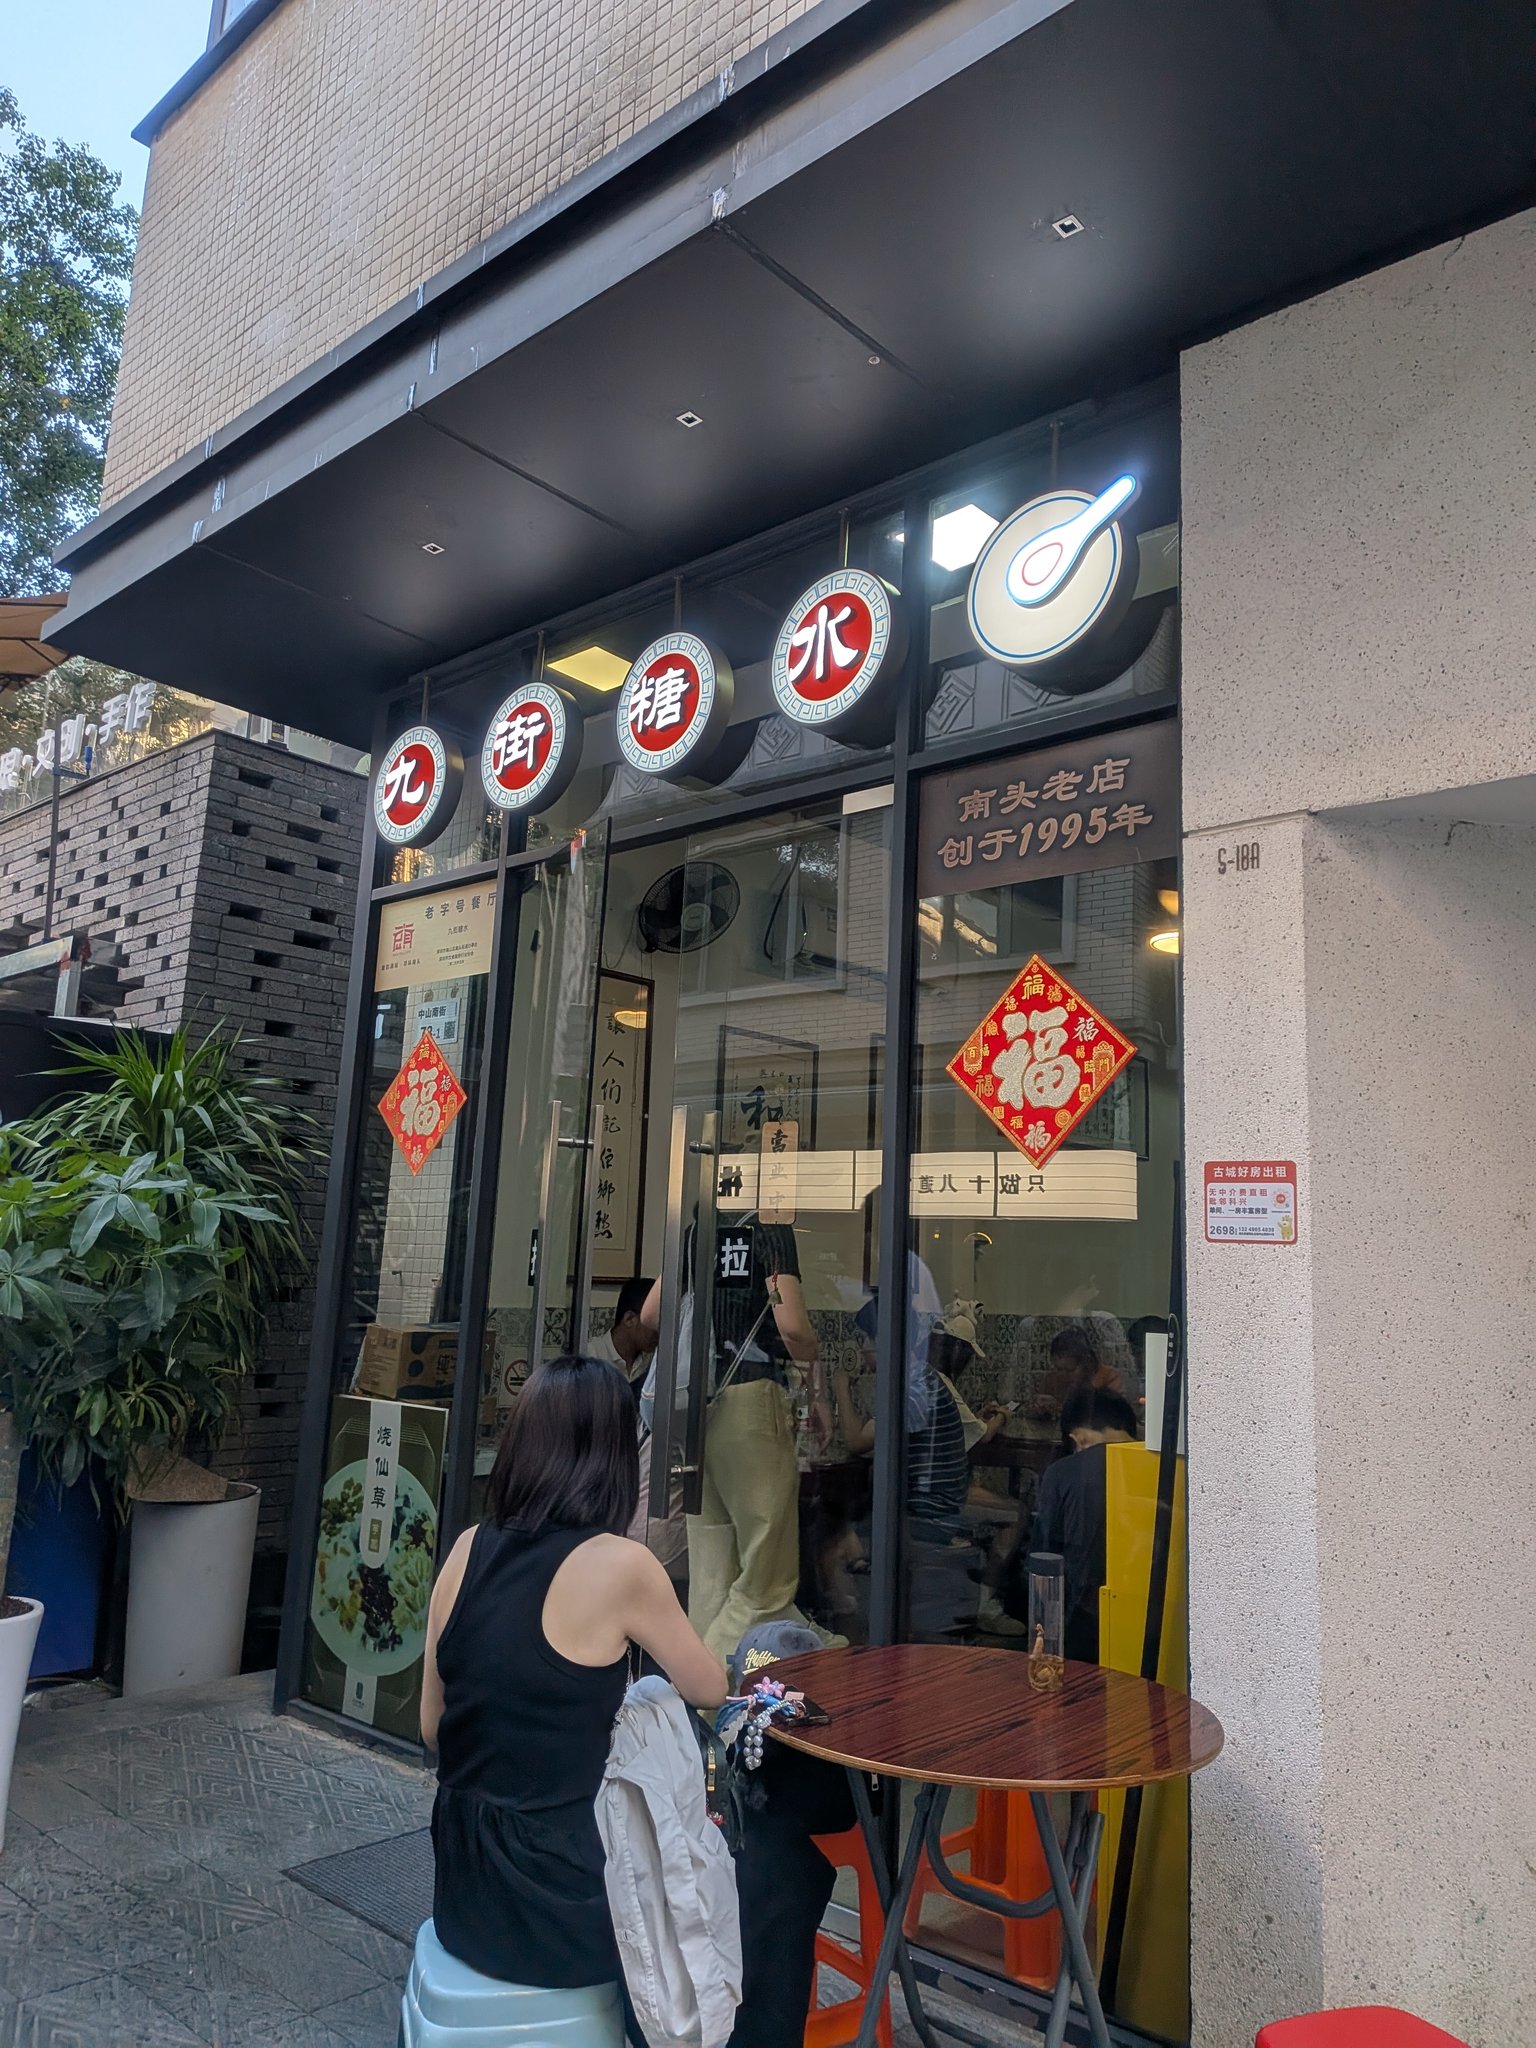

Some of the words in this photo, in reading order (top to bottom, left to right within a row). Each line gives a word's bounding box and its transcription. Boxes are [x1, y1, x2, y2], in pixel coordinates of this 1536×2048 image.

[958, 758, 1131, 823] 南头老店
[937, 803, 1153, 868] 创于1995年
[1218, 842, 1260, 875] S-18A
[425, 892, 496, 919] 老字号餐厅
[1021, 973, 1045, 1001] 福
[418, 1006, 447, 1019] 中山南街
[1072, 1016, 1099, 1042] 福
[992, 1005, 1081, 1111] 福
[400, 1067, 441, 1137] 福
[1213, 1166, 1287, 1178] 古城好房出租
[1209, 1225, 1235, 1235] 2698
[721, 1237, 749, 1277] 拉
[370, 1425, 393, 1509] 烧仙草
